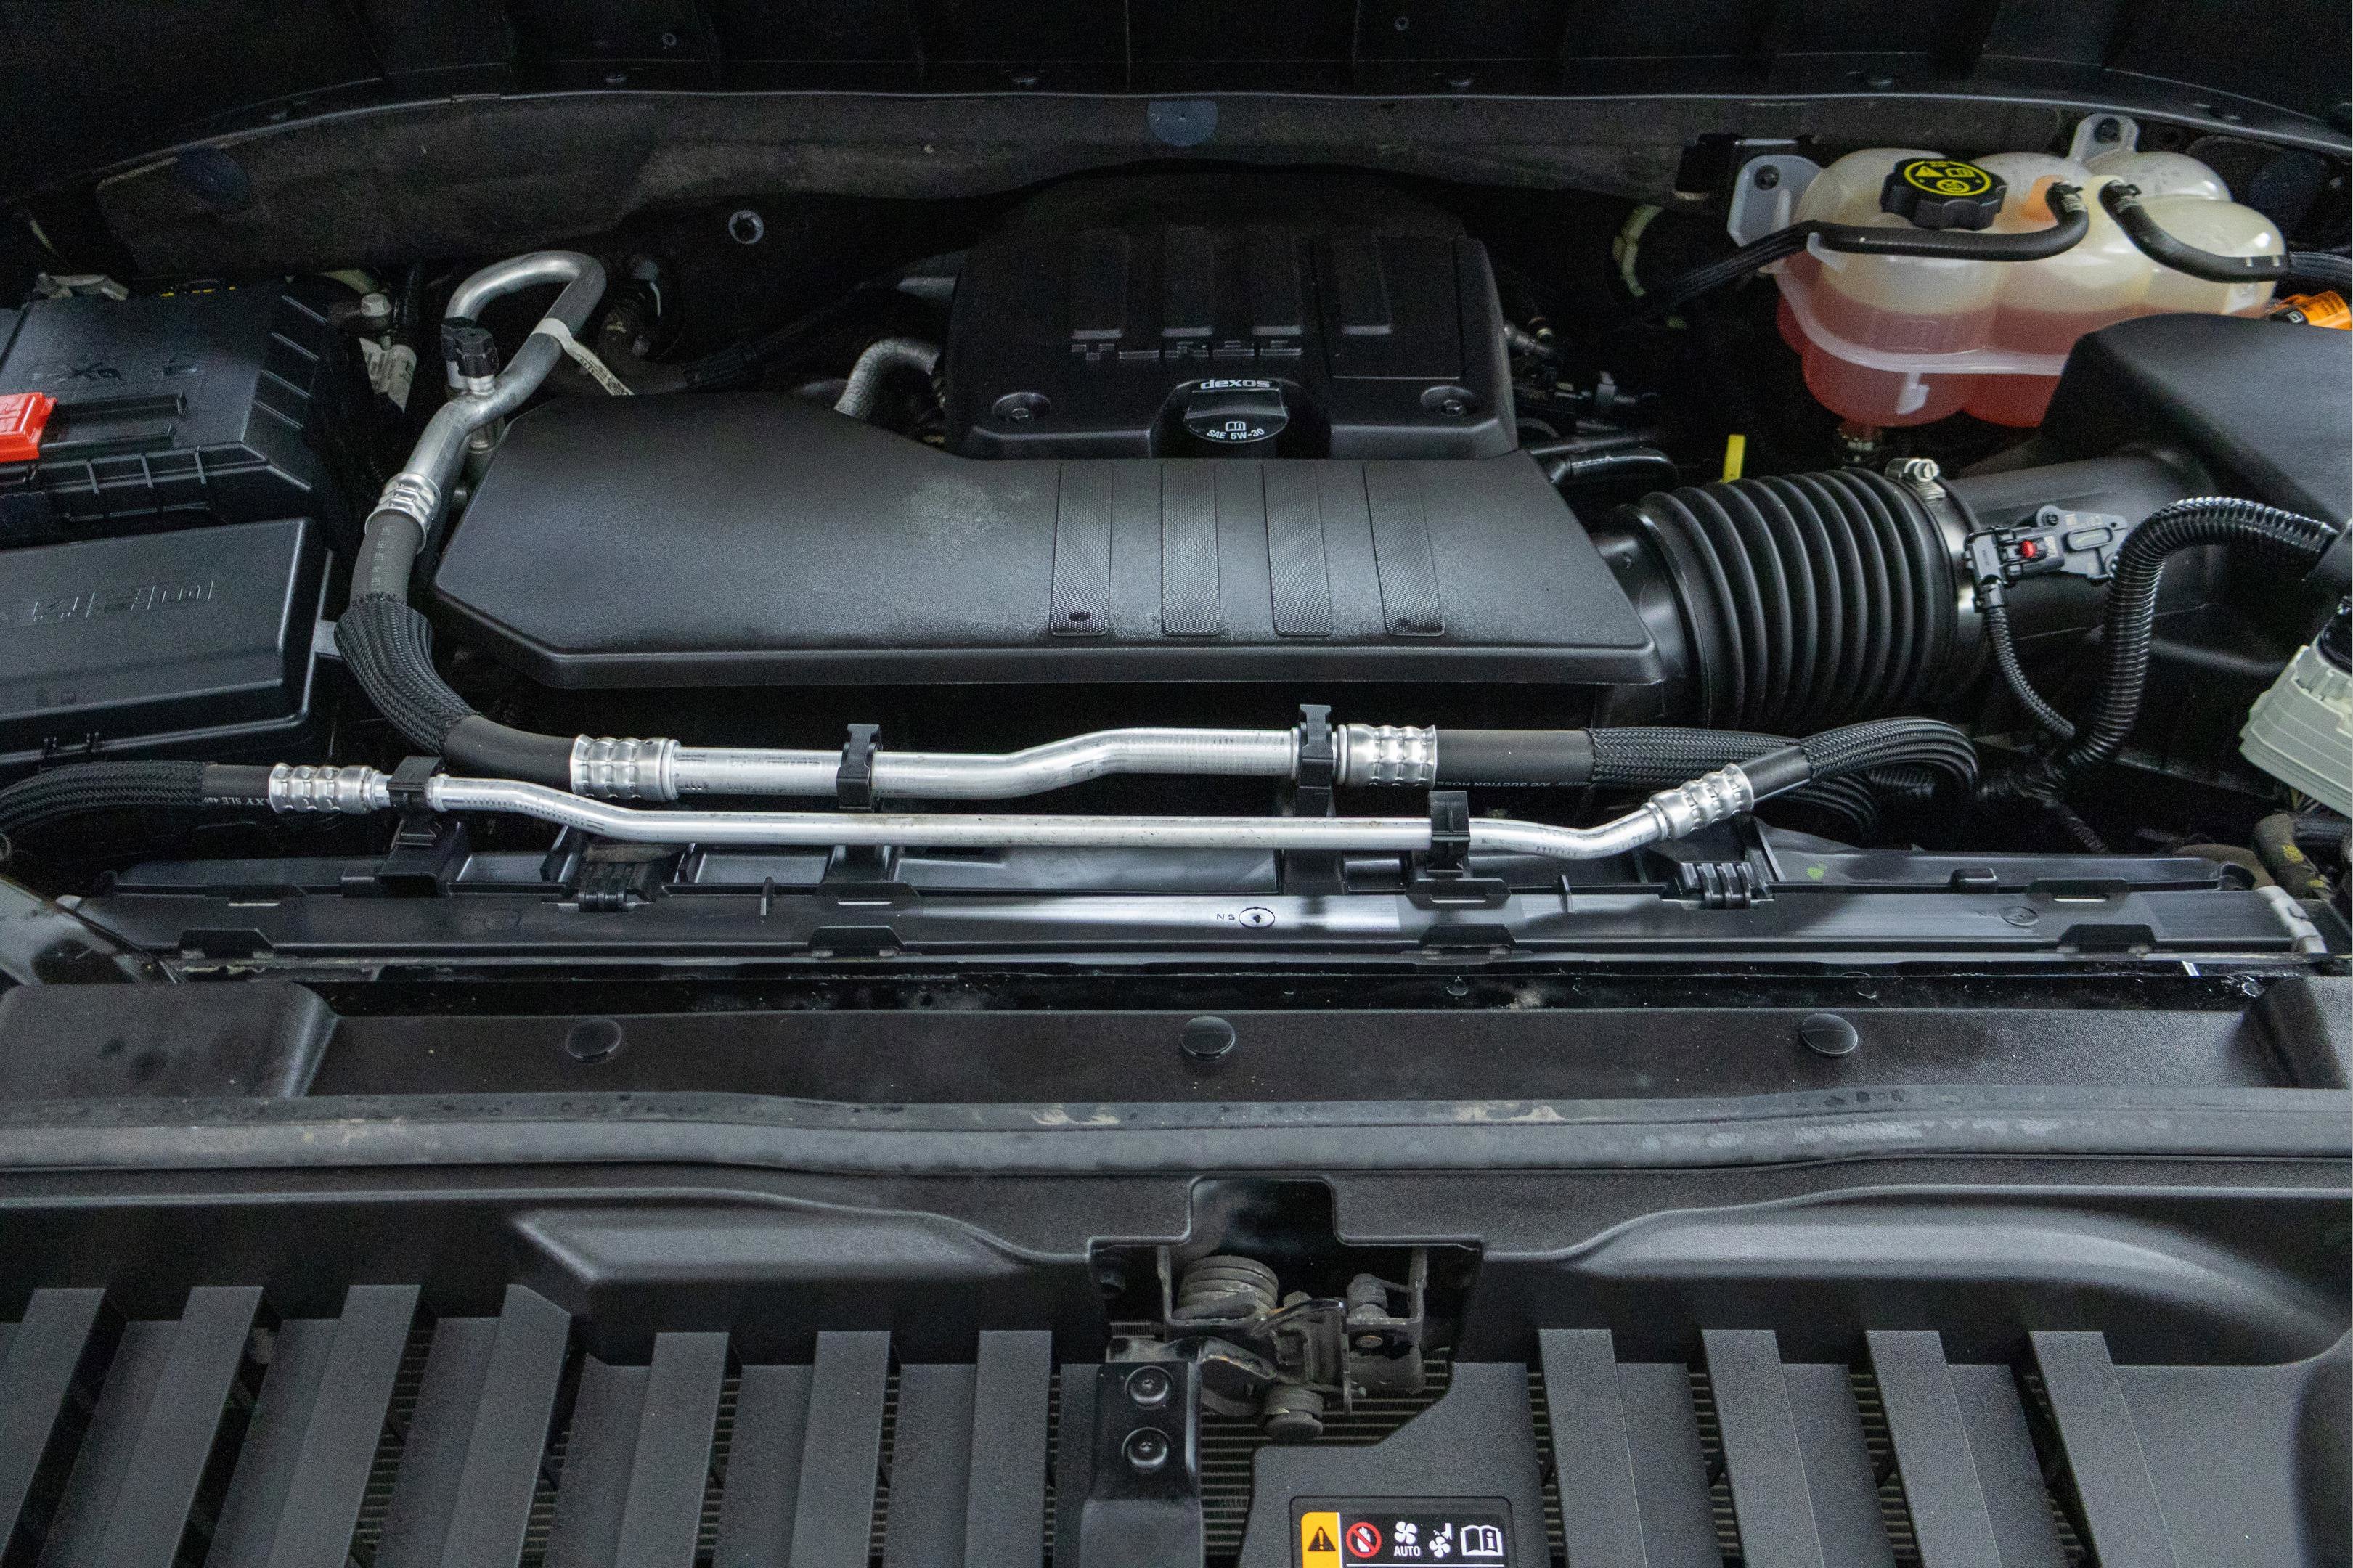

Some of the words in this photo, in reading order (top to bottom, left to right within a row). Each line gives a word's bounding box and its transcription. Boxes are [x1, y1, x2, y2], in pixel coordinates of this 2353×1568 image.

[1200, 380, 1271, 390] dexos
[1207, 430, 1227, 439] SAE
[1230, 428, 1265, 439] 5W-30
[221, 796, 242, 805] SLE
[1393, 1545, 1421, 1557] AUTO
